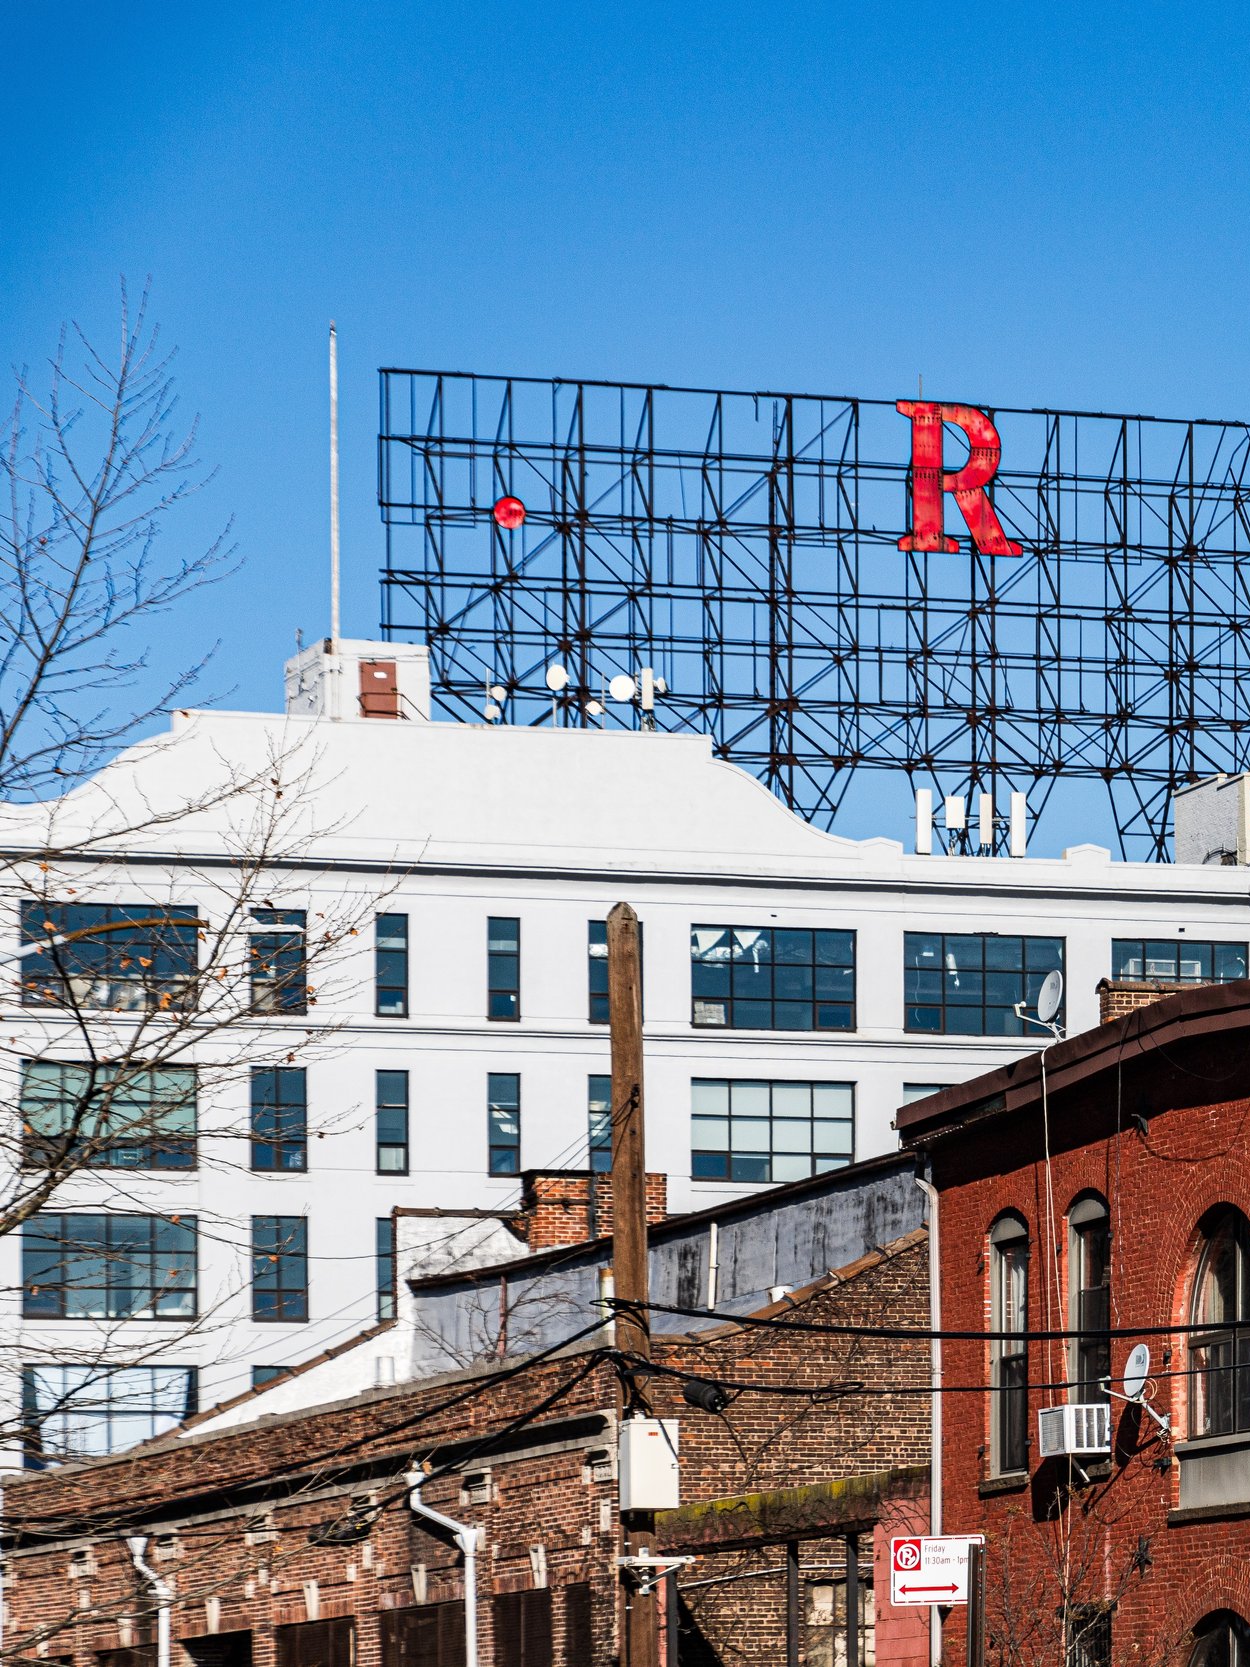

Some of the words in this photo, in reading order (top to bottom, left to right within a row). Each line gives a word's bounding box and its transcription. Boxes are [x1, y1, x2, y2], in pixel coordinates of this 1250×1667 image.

[896, 400, 1023, 556] R
[924, 1544, 946, 1553] Friday
[925, 1556, 951, 1565] 1130am
